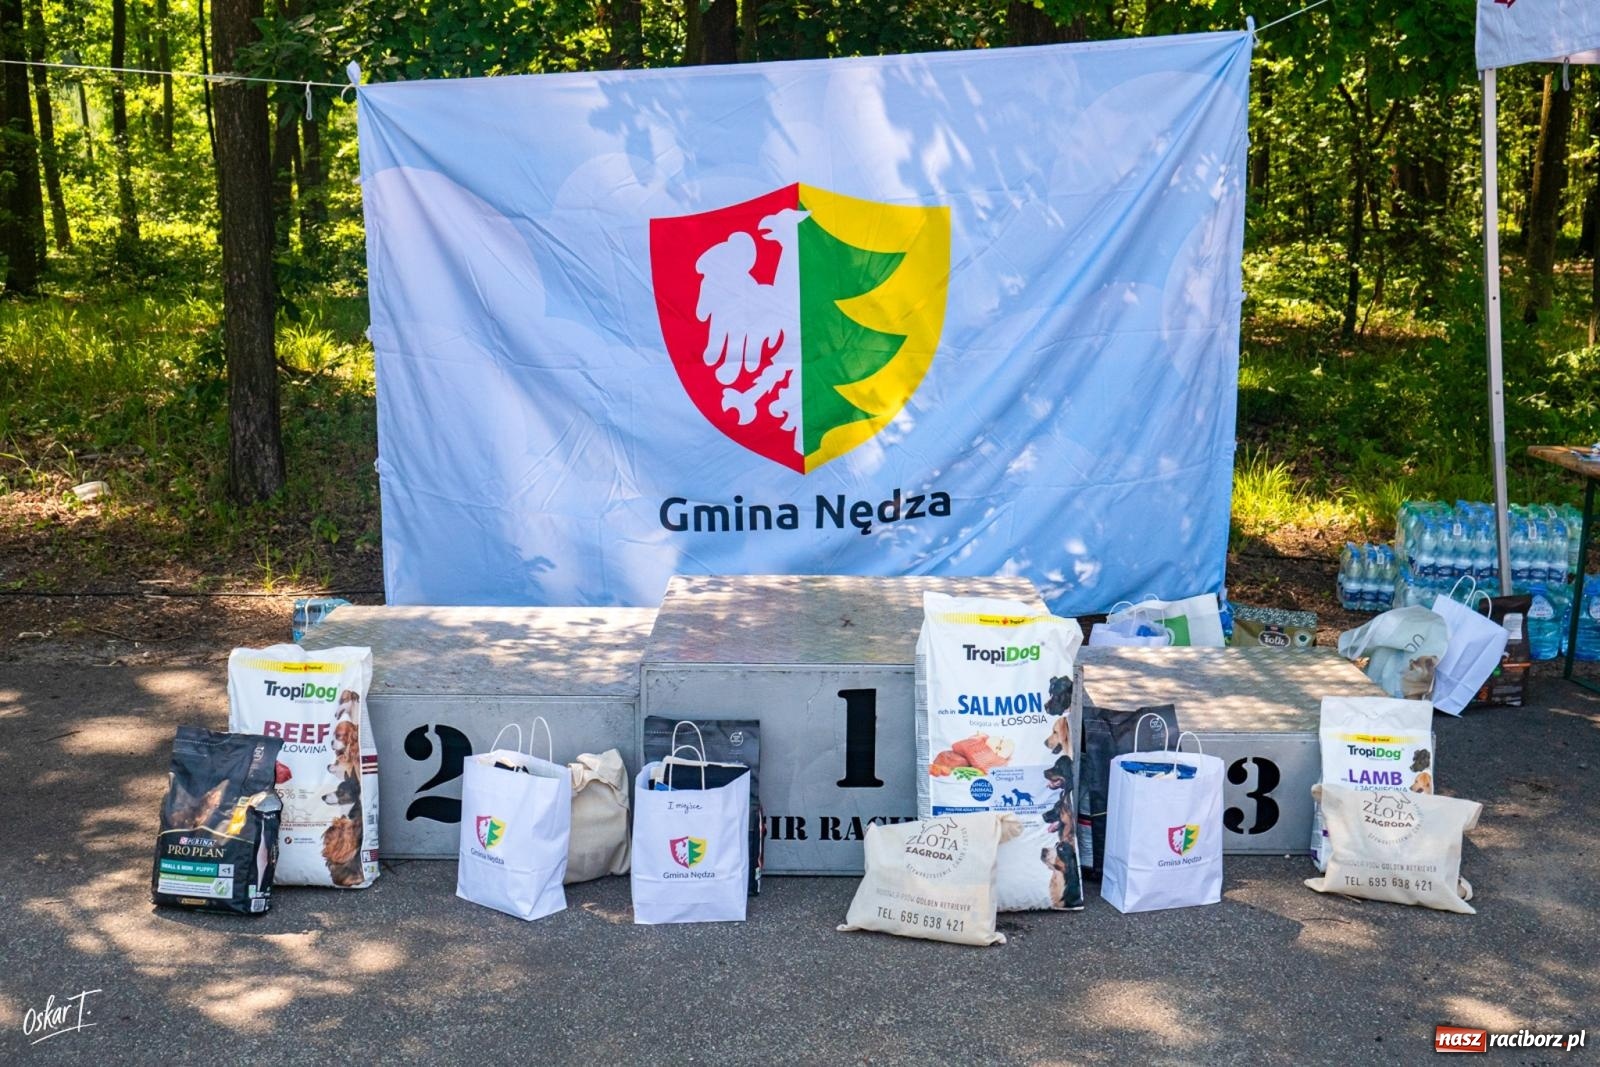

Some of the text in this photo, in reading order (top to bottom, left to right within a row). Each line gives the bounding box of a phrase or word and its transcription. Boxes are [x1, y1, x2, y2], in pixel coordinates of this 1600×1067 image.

[660, 488, 951, 535] Gmina Nędza
[962, 644, 1041, 664] TropiDog
[264, 680, 338, 702] TropiDog
[958, 692, 1042, 716] SALMON
[1001, 715, 1048, 727] ŁOSOSIA
[263, 720, 331, 744] BEEF
[836, 688, 885, 788] 1
[282, 744, 327, 754] ŁOWINA
[1347, 744, 1402, 760] TropiDog
[404, 724, 473, 823] 2
[1348, 769, 1403, 786] LAMB
[1223, 756, 1280, 835] 3
[1362, 800, 1415, 820] ZŁOTA
[763, 816, 808, 841] IR
[1364, 815, 1412, 828] ZAGRODA
[168, 844, 225, 858] PRO PLAN
[905, 846, 953, 861] ZAGRODA
[1158, 855, 1202, 867] Gmina Nędza
[663, 870, 716, 879] Gmina Nędza
[1368, 877, 1387, 887] 695
[1391, 878, 1410, 889] 638
[1414, 879, 1432, 891] 421
[877, 906, 965, 932] TEL. 695 638 421
